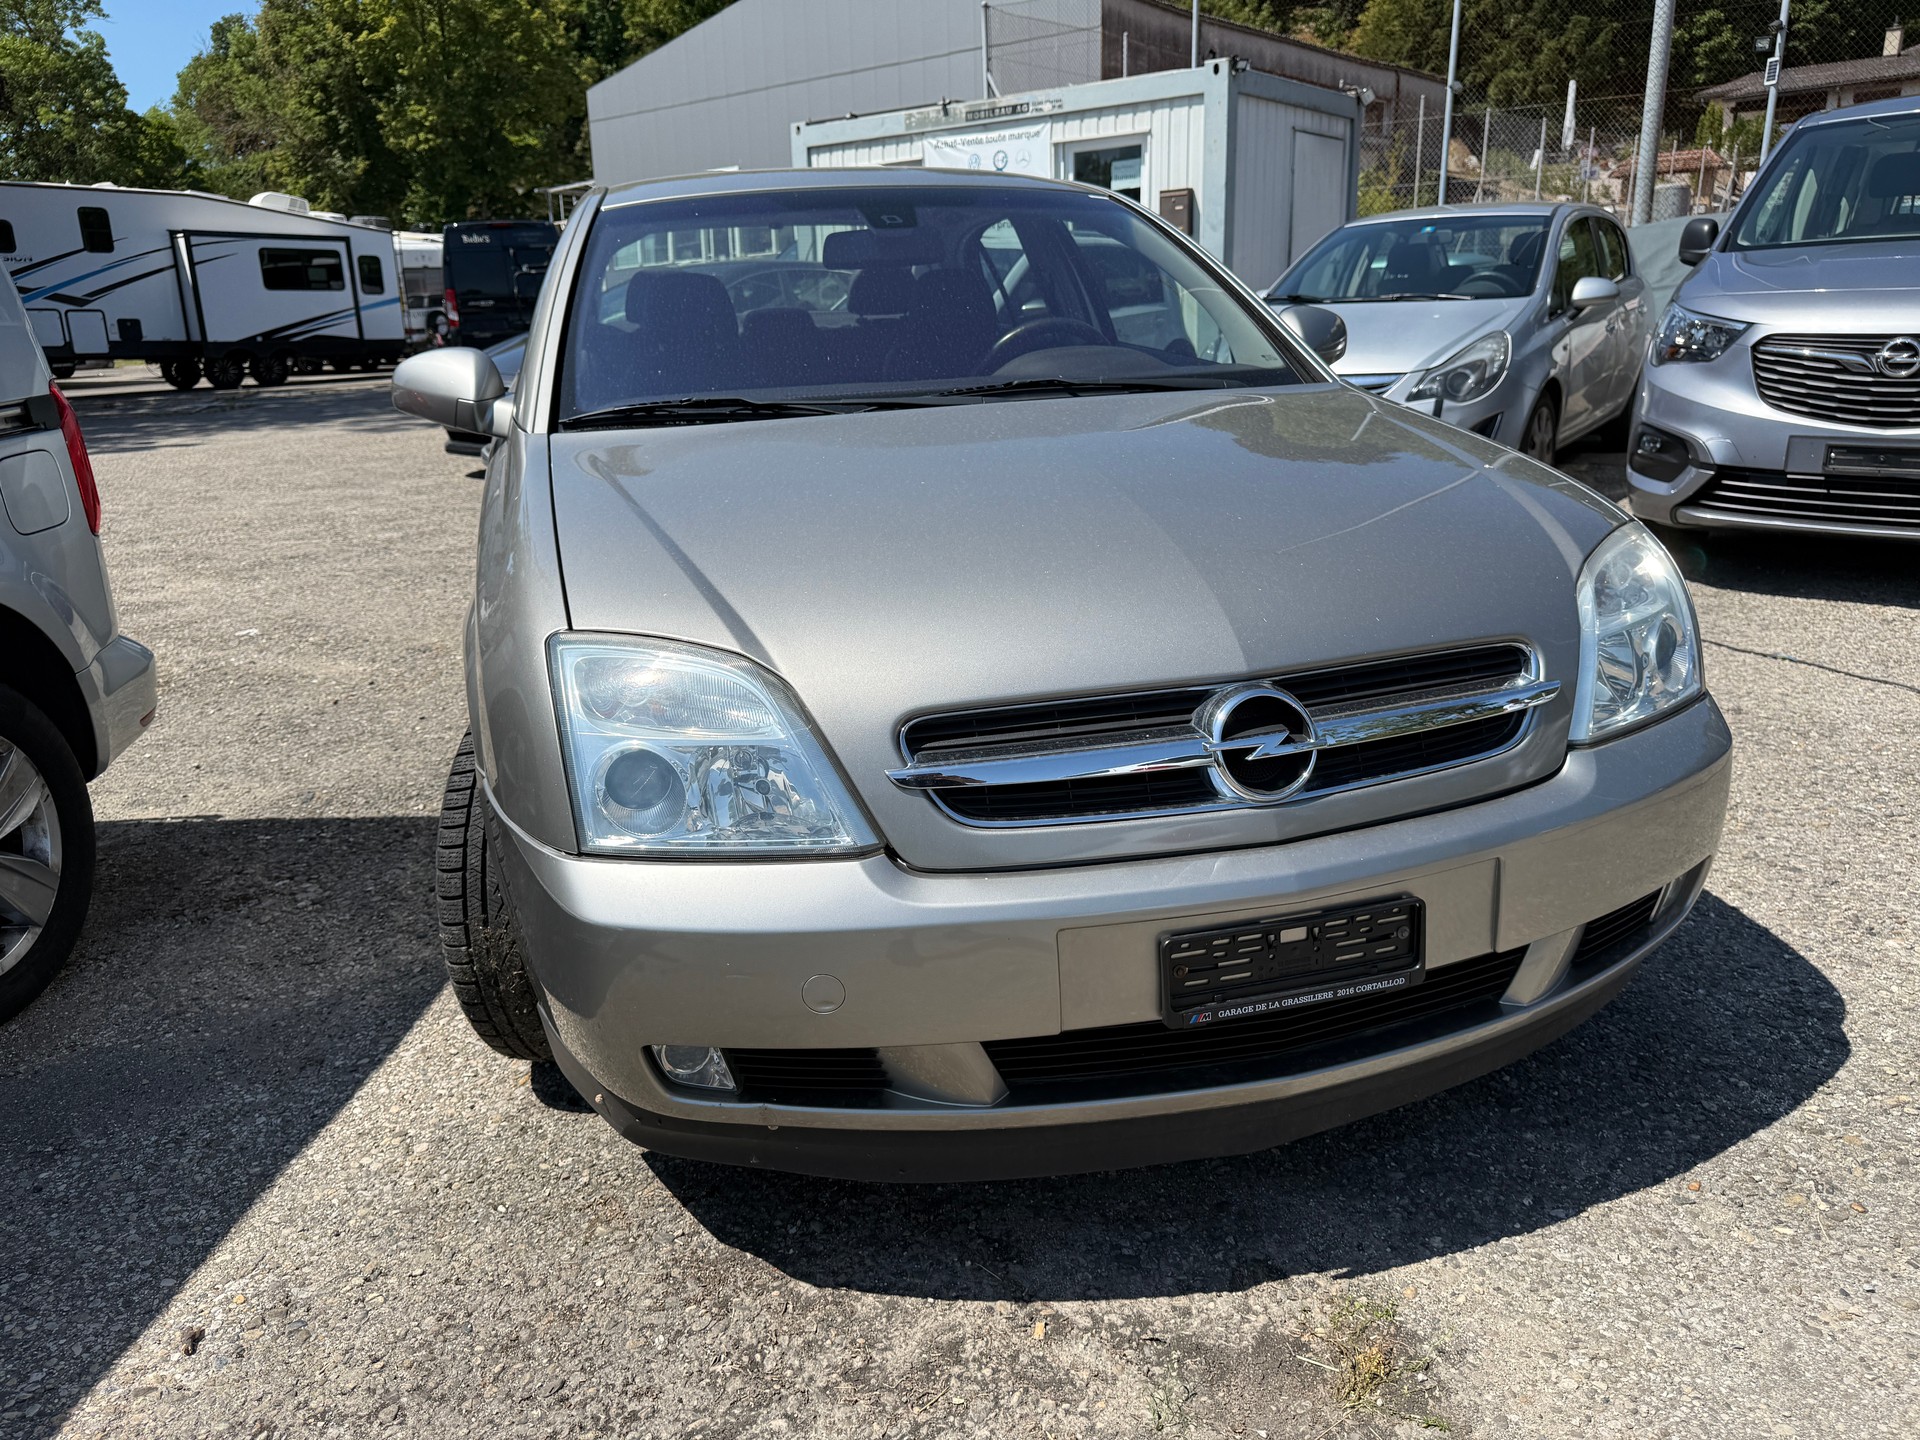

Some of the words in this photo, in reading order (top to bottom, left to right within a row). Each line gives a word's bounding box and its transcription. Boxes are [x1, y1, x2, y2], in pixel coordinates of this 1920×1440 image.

[1016, 104, 1028, 113] AG
[985, 134, 1007, 145] toute
[1008, 130, 1040, 143] marque
[1218, 1005, 1254, 1018] GARAGE
[1256, 1003, 1267, 1013] DE
[1268, 1001, 1280, 1010] LA
[1282, 991, 1333, 1007] GRASSILIERE
[1337, 986, 1354, 998] 2016
[1356, 977, 1405, 993] CORTAILLOD
